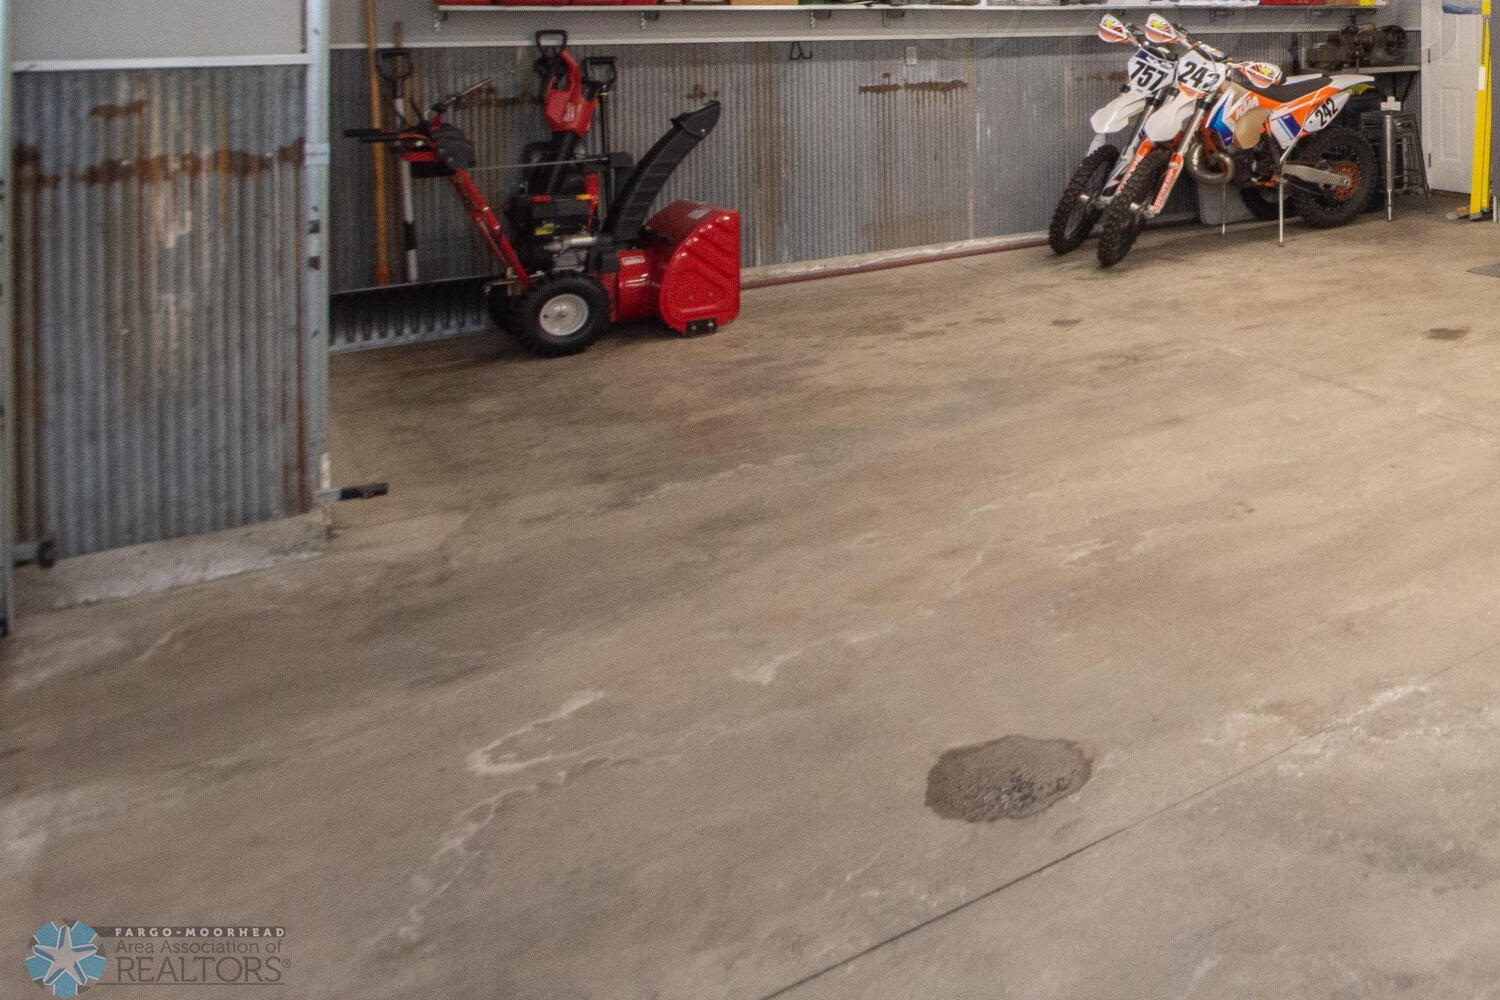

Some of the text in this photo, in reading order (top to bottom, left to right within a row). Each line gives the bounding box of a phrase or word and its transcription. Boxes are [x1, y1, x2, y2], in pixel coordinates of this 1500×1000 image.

[1130, 60, 1168, 91] 757
[1177, 61, 1221, 92] 242
[1315, 96, 1339, 126] 242
